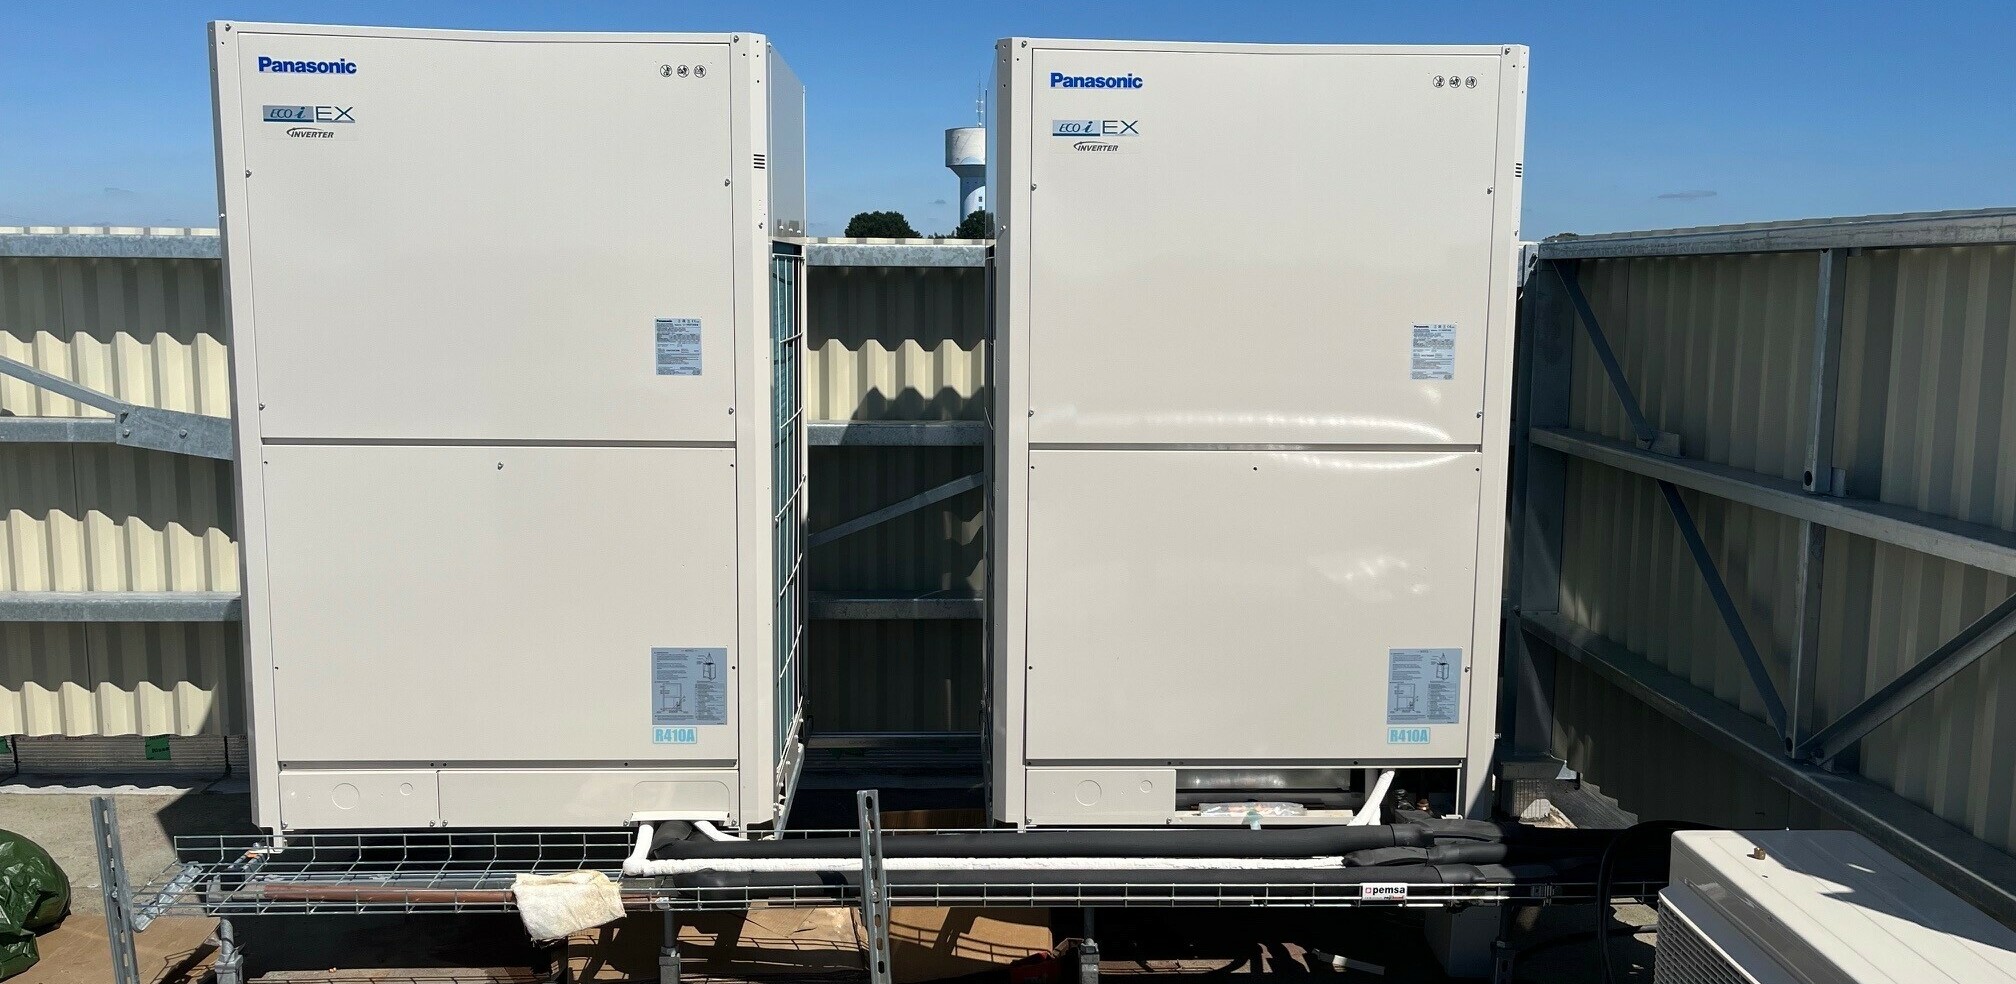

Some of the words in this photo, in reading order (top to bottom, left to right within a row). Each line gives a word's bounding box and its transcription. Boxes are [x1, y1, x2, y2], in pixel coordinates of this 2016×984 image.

[258, 56, 357, 75] Panasonic
[1050, 72, 1143, 89] Panasonic
[270, 108, 293, 119] ECO
[315, 106, 355, 121] EX
[287, 128, 334, 139] INVERTER
[1059, 122, 1082, 133] ECO
[1102, 120, 1139, 134] EX
[1074, 142, 1119, 152] INVERTER
[655, 728, 695, 742] R410A
[1390, 729, 1428, 743] R410A
[1372, 886, 1406, 896] pemsa
